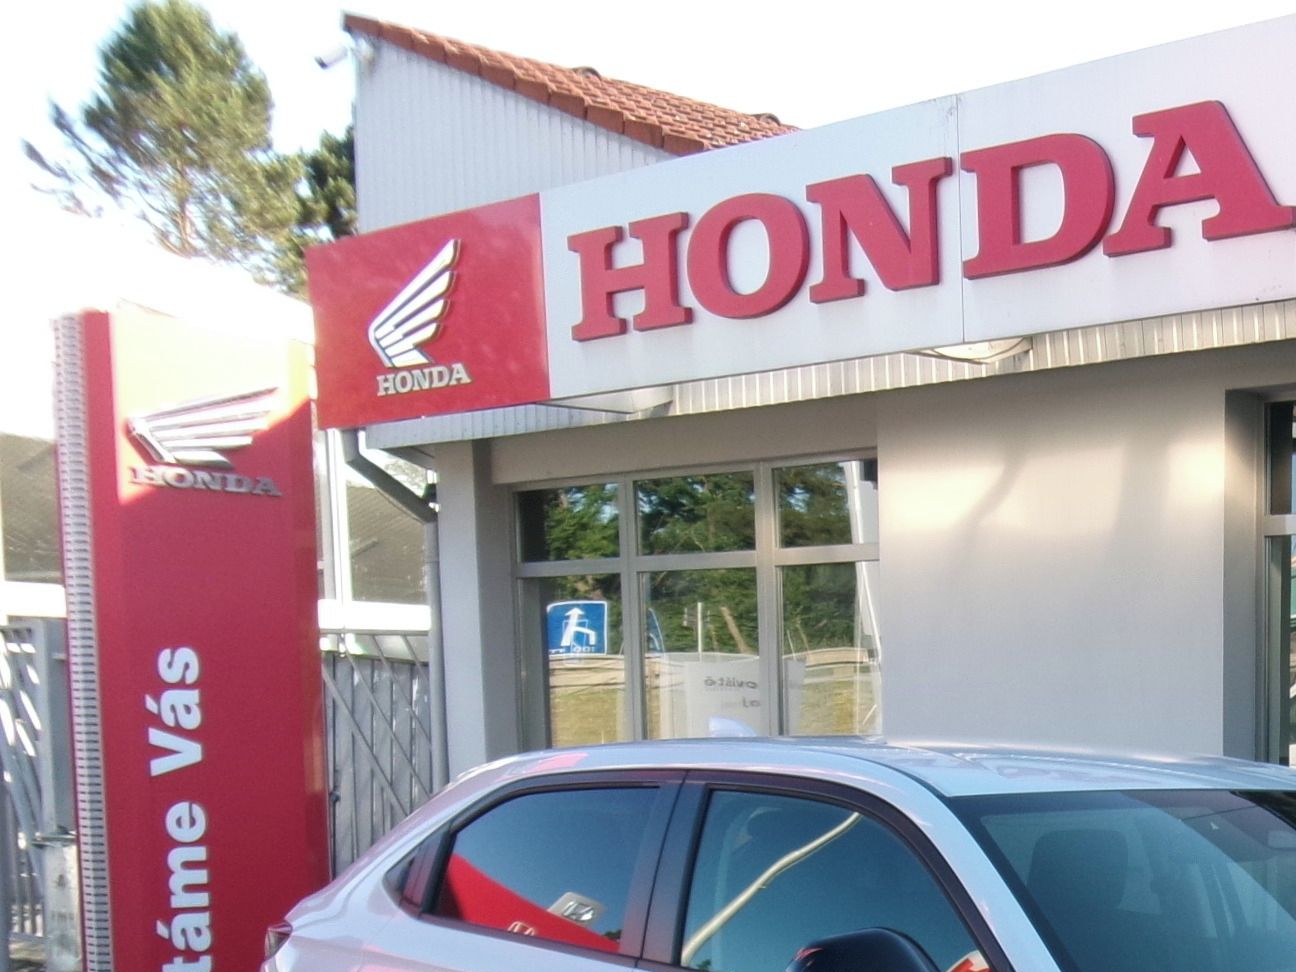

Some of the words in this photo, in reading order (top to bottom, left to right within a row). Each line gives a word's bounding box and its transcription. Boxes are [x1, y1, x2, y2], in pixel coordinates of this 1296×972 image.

[377, 362, 471, 396] HONDA
[126, 465, 283, 498] HONDA
[145, 645, 204, 777] Vás
